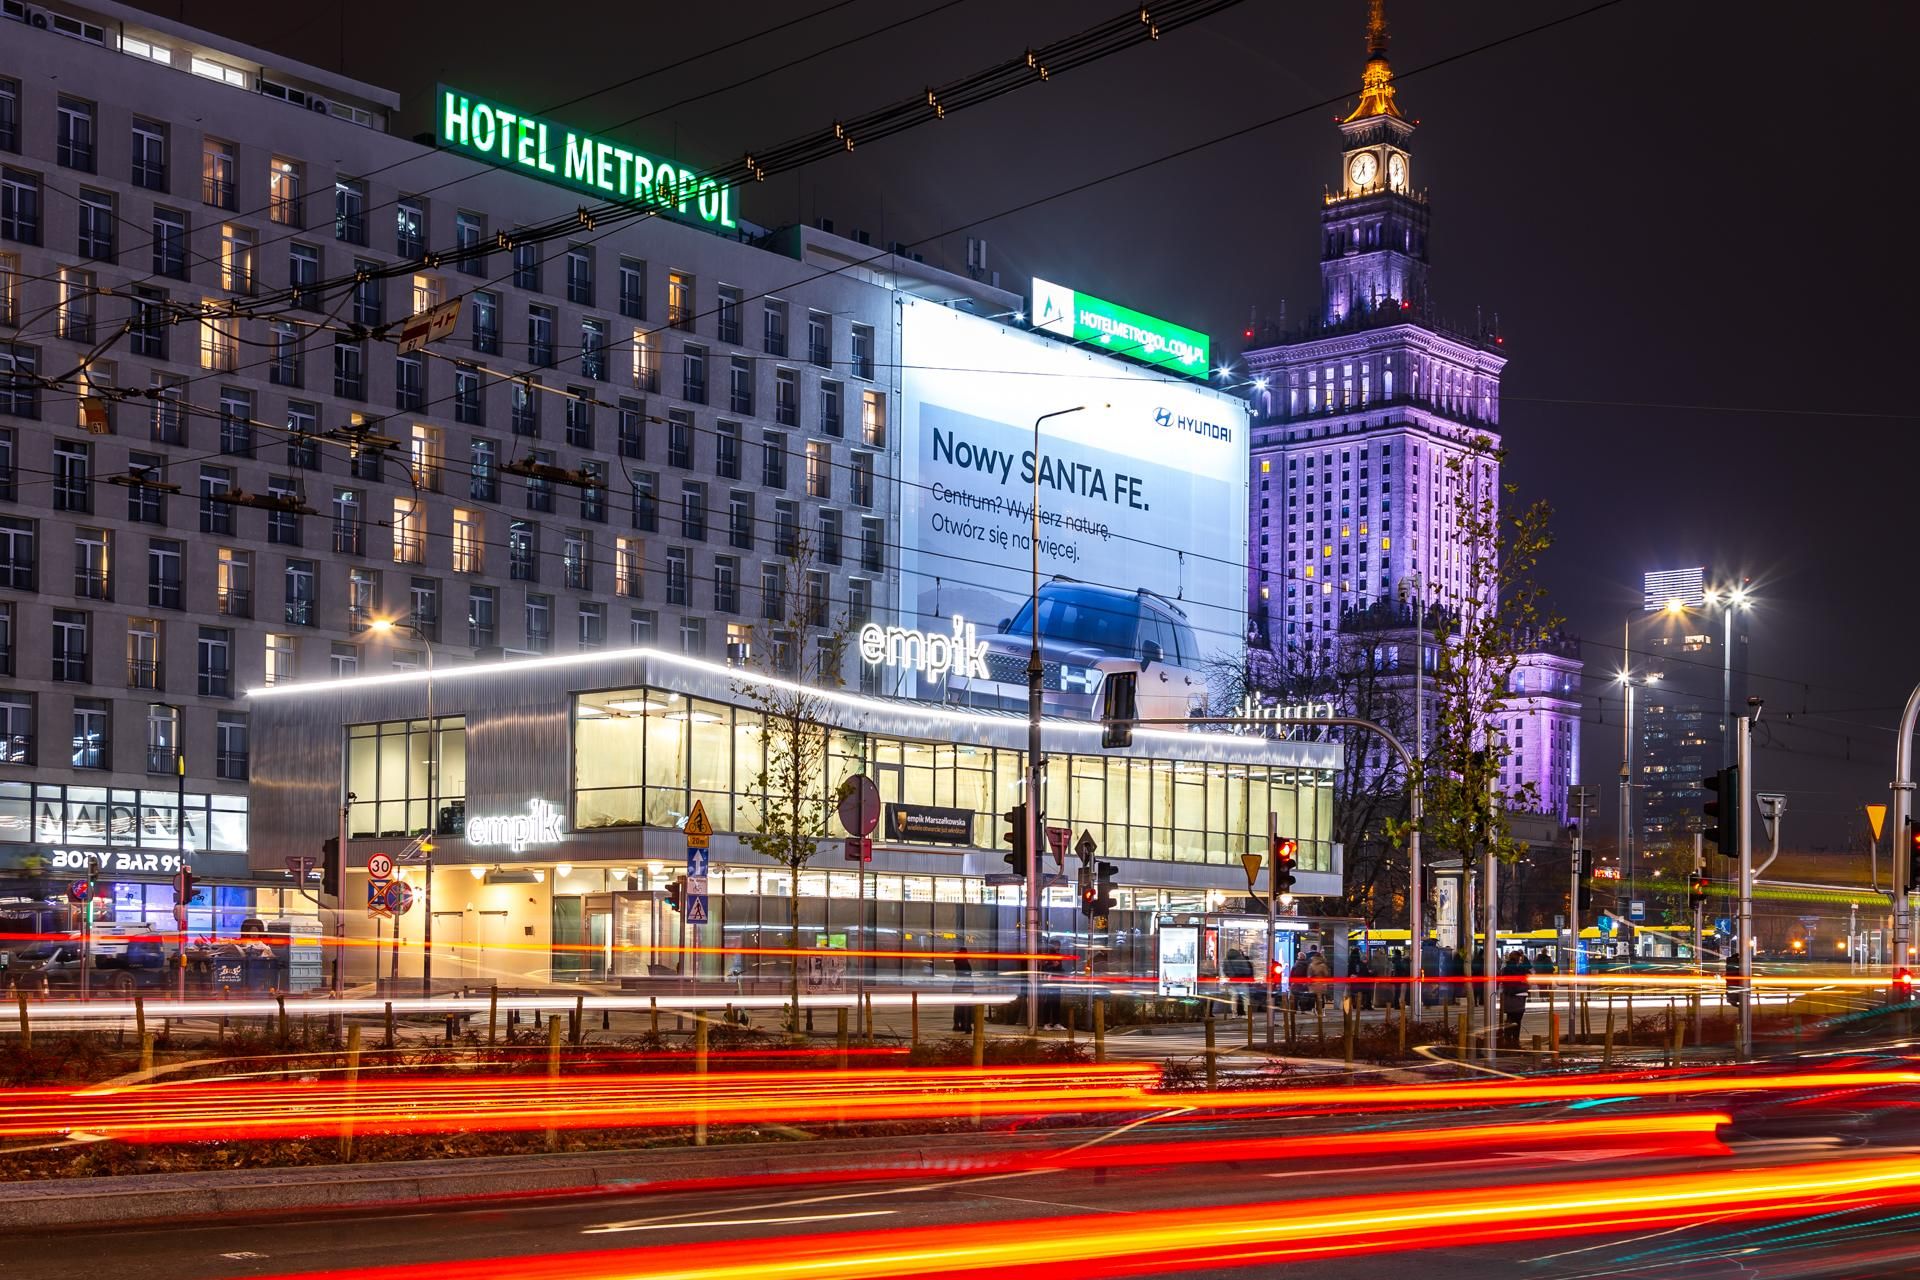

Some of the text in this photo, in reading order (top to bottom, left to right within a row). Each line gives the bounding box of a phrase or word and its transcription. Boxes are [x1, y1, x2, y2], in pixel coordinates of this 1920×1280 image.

[445, 92, 736, 229] HOTEL METROPOL
[1080, 310, 1206, 363] HOTELMETROPOL.COM.PL
[1178, 415, 1232, 443] HYUNDAI
[933, 428, 1149, 511] Nowy SANTA FE.
[932, 482, 1111, 543] Centrum? Wybierz naturę.
[932, 513, 985, 541] Otwórz
[989, 525, 1008, 549] się
[1013, 534, 1029, 550] na
[859, 614, 990, 684] empik
[467, 798, 566, 853] empik
[907, 814, 924, 824] empik
[52, 850, 112, 869] BODY
[115, 853, 158, 871] BAR
[372, 859, 390, 872] 30
